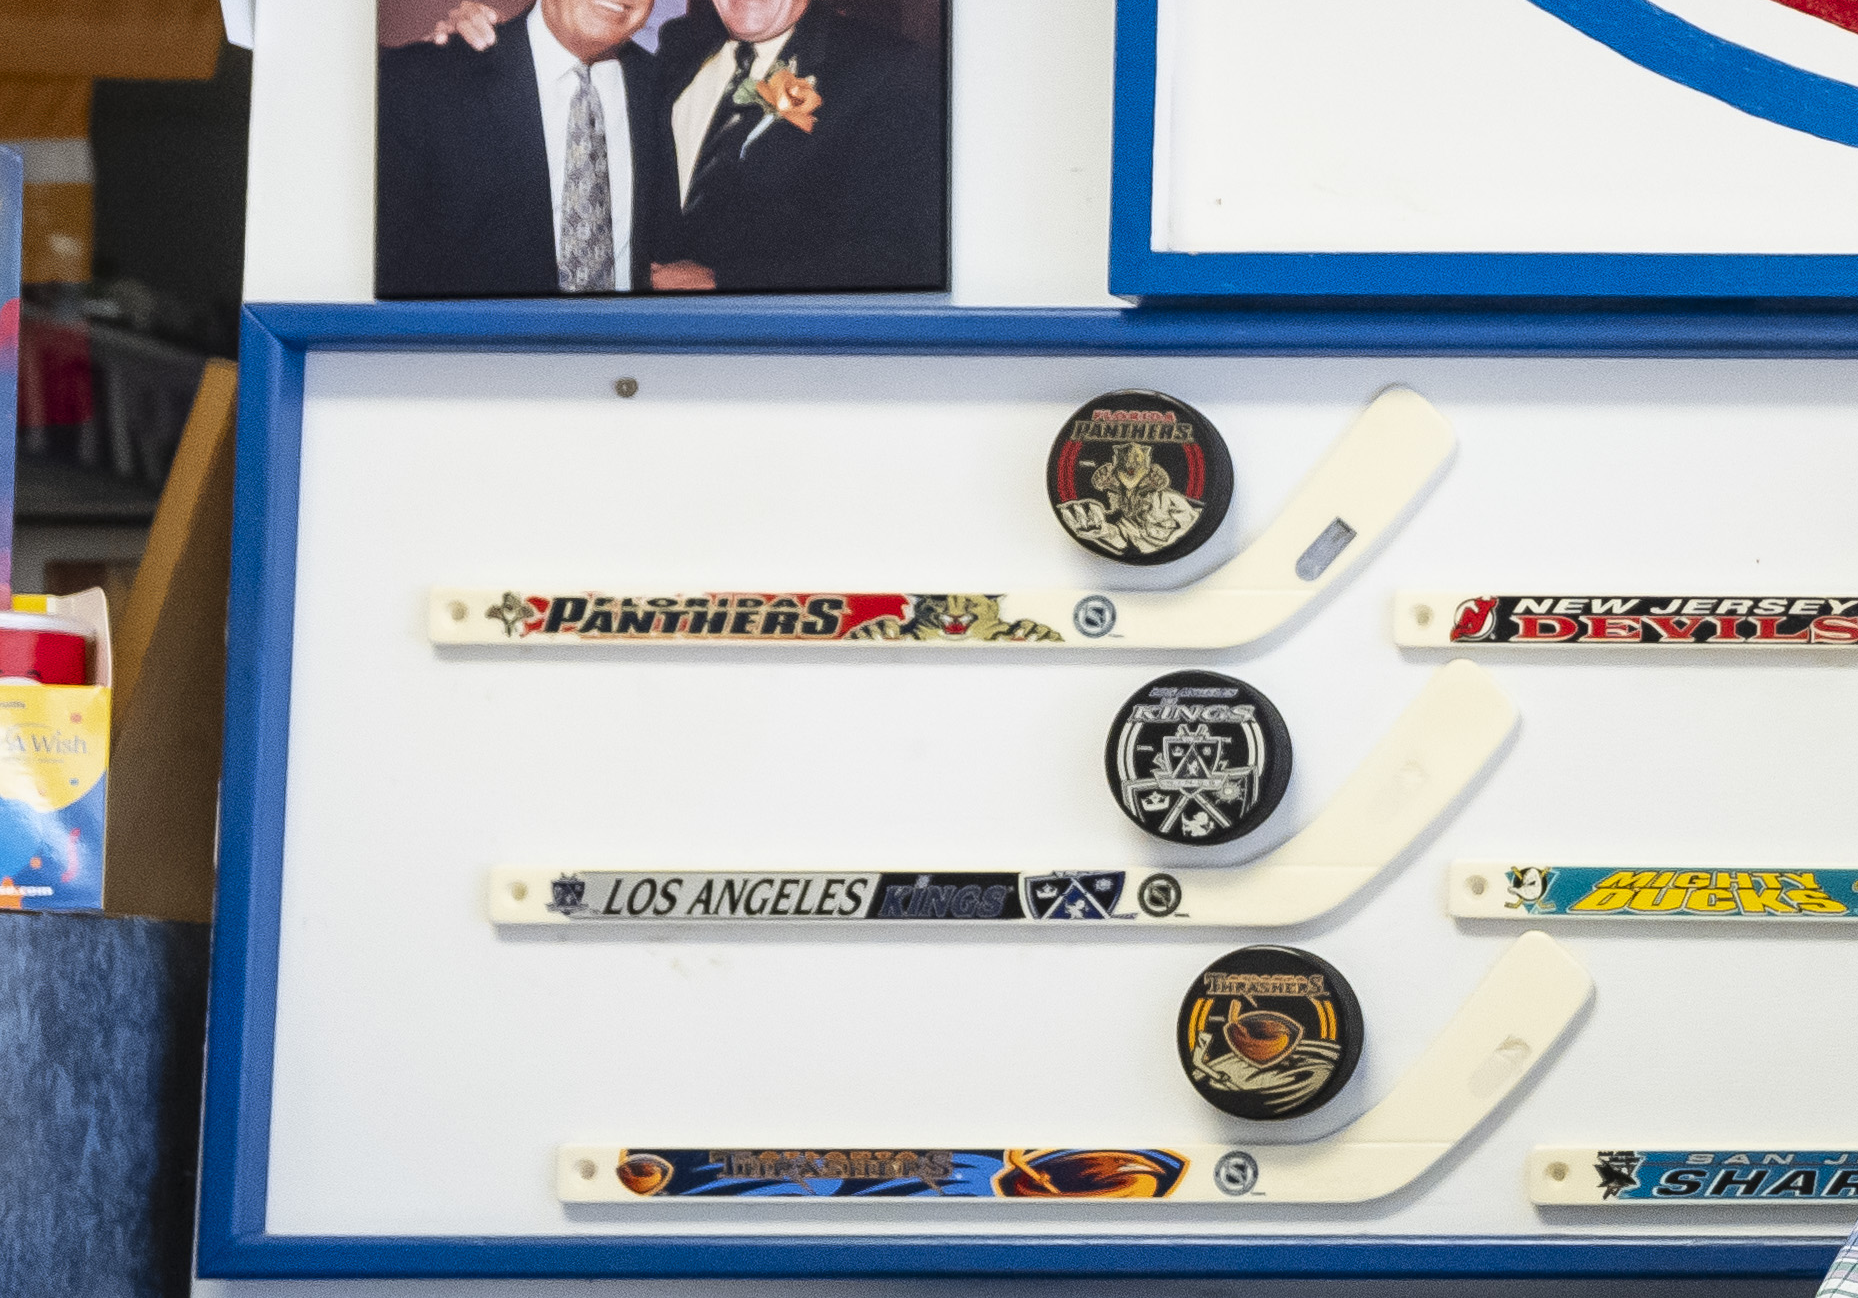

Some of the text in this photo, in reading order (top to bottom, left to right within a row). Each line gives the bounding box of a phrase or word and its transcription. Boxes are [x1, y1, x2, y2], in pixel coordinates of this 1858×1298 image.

[544, 596, 846, 636] PANTHERS
[1513, 599, 1642, 615] NEW
[1128, 702, 1255, 723] KINGS
[1595, 870, 1819, 890] MIGHTY
[602, 874, 1005, 919] LOS ANGELES KINGS
[1568, 888, 1849, 915] DUCKS
[1685, 1153, 1796, 1166] SAN
